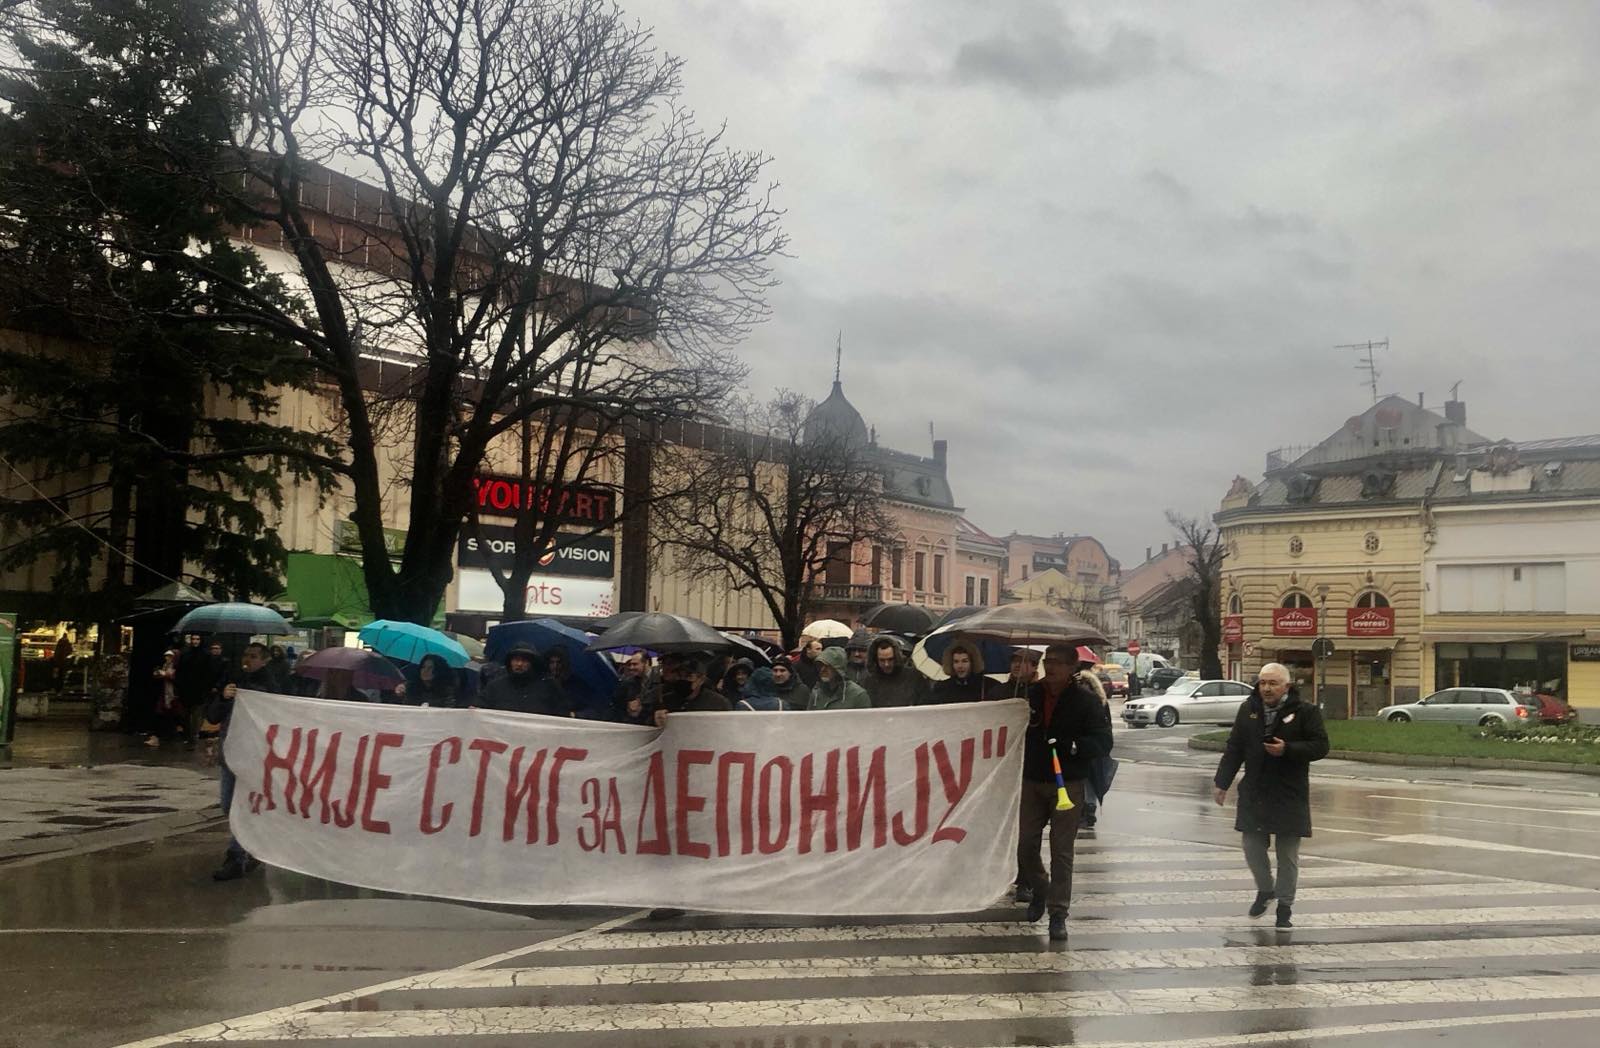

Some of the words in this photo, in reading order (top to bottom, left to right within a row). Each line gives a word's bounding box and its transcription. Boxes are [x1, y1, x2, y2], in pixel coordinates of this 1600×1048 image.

[559, 547, 610, 563] VISION
[420, 736, 589, 845] СТИГ
[577, 776, 627, 854] ЗА
